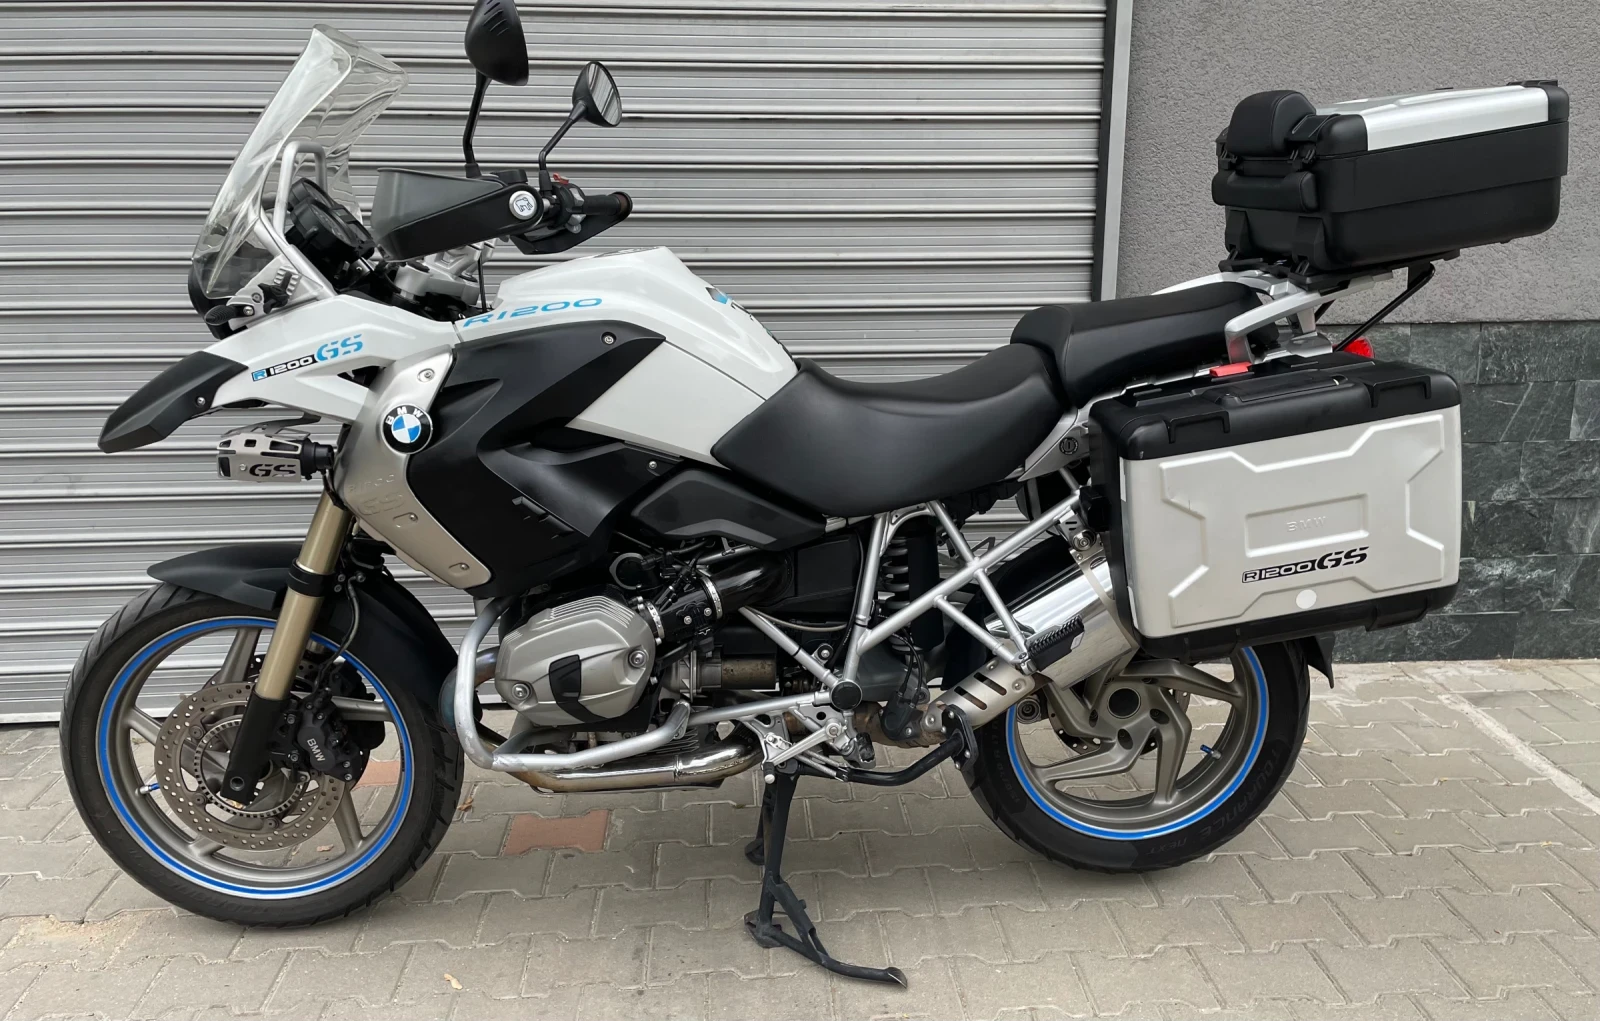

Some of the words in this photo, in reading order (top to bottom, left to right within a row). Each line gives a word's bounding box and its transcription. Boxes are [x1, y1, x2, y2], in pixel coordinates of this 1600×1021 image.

[463, 298, 603, 328] R1200
[385, 406, 424, 426] BMW
[249, 463, 297, 478] GS
[1286, 515, 1328, 532] BMW
[307, 738, 326, 762] BMW
